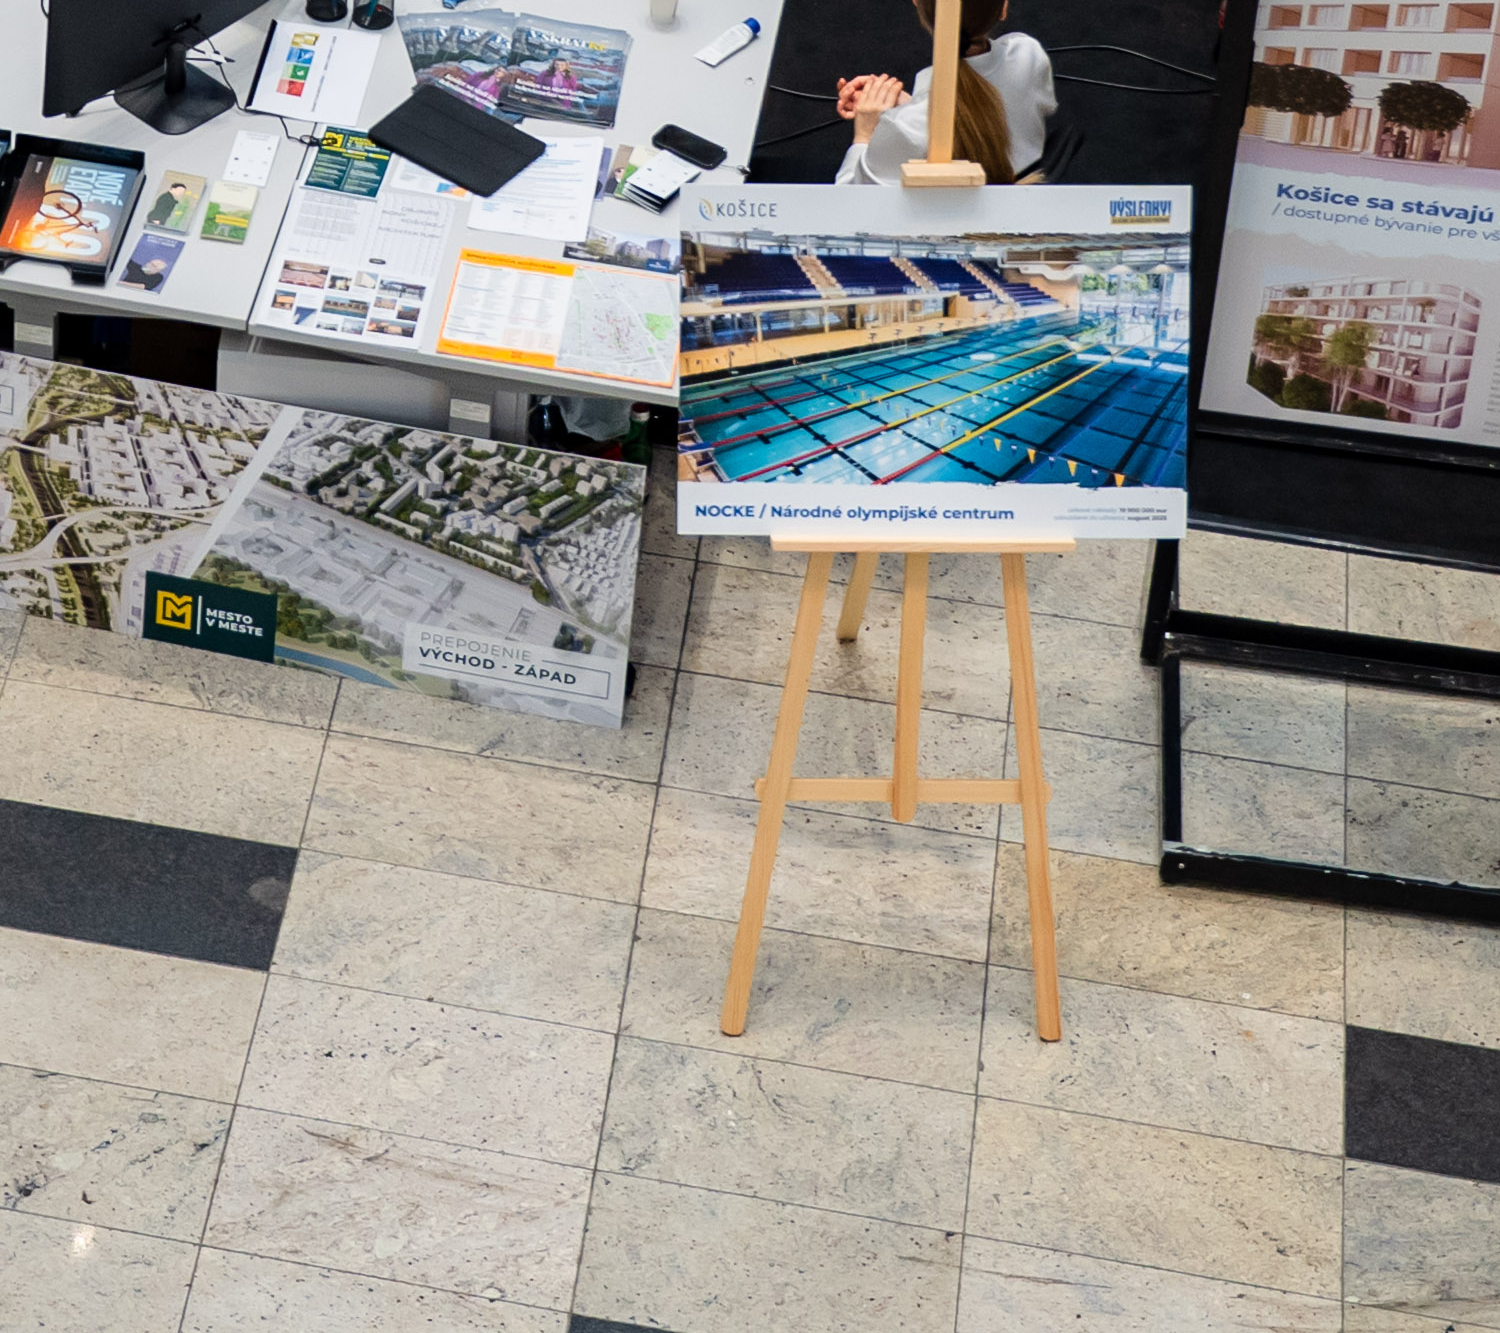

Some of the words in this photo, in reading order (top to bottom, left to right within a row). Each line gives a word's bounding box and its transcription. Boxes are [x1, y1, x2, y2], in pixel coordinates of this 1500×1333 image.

[89, 171, 126, 206] NOVÉ
[1276, 183, 1360, 207] Košice
[1366, 196, 1394, 211] sa
[1402, 197, 1494, 224] stávajú
[716, 199, 778, 218] KOŠICE
[1284, 205, 1370, 227] dostupné
[1375, 215, 1443, 235] bývanie
[1448, 226, 1477, 240] pre
[695, 504, 756, 519] NOCKE
[770, 502, 842, 520] Národné
[847, 504, 938, 523] olympijské
[942, 506, 1015, 521] centrum
[206, 607, 253, 625] MESTO
[206, 617, 216, 627] V
[218, 619, 263, 637] MESTE
[420, 631, 531, 662] PREPOJENIE
[418, 645, 495, 670] VÝCHOD
[513, 663, 577, 686] ZÁPAD
